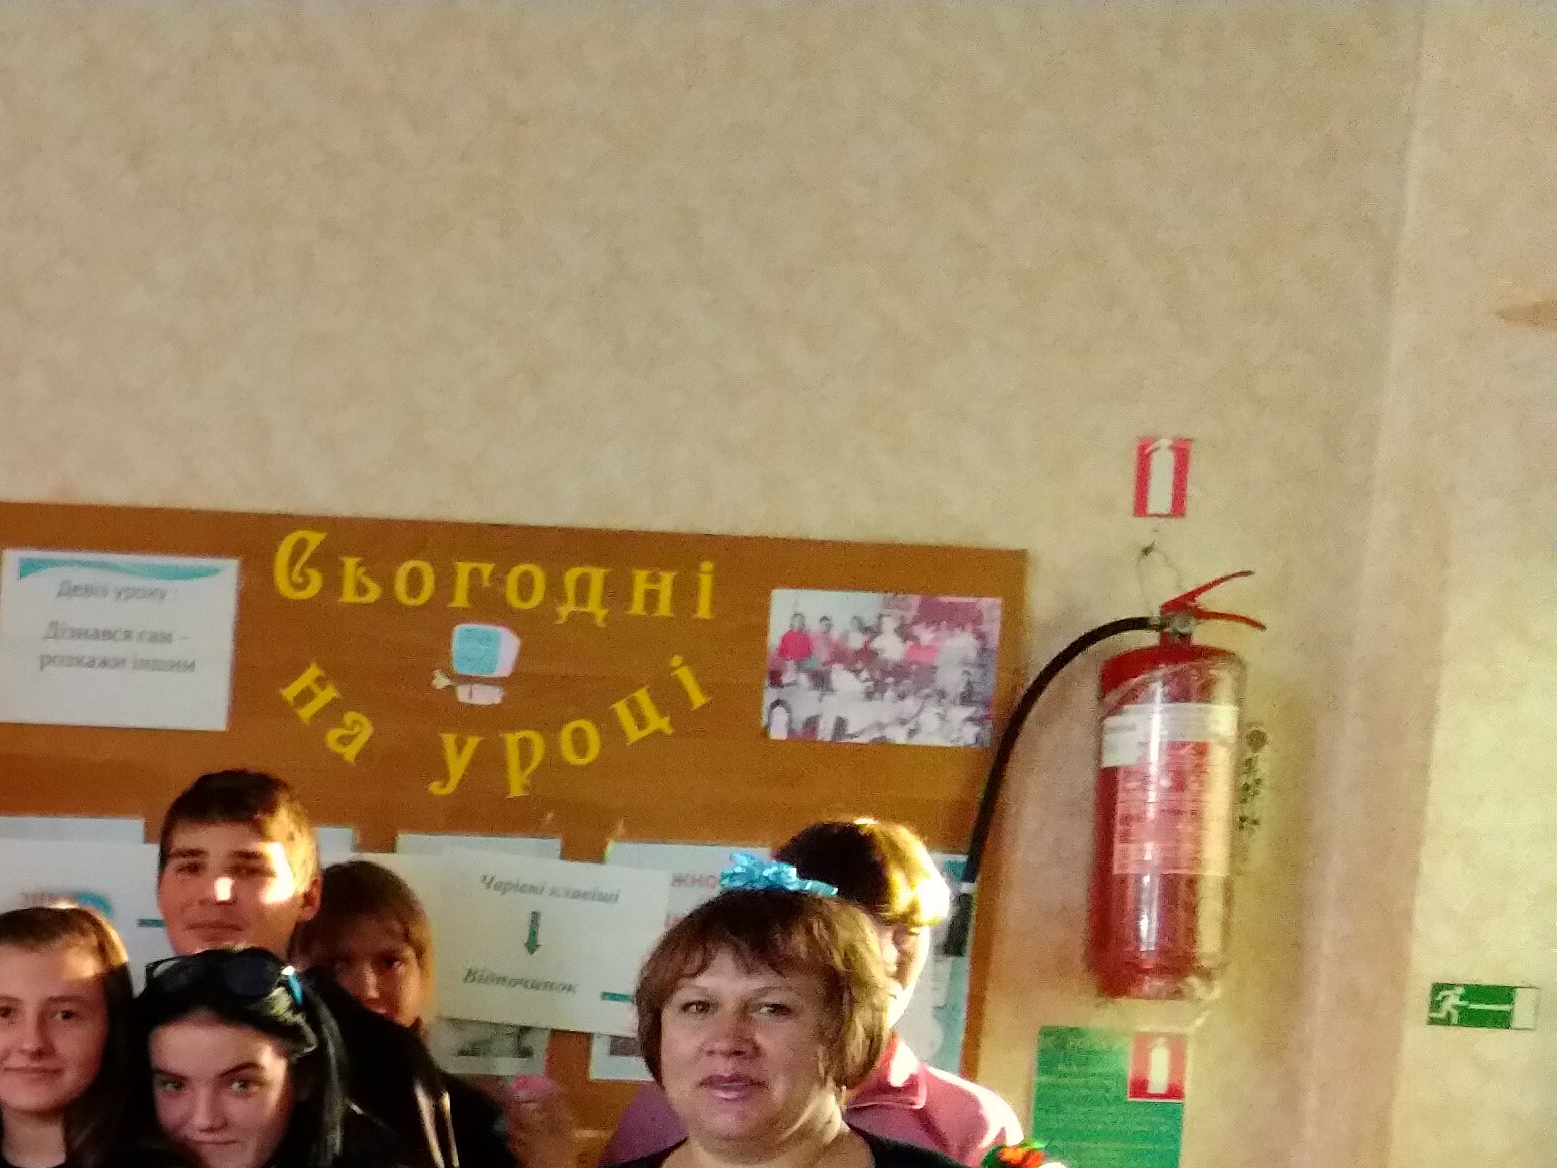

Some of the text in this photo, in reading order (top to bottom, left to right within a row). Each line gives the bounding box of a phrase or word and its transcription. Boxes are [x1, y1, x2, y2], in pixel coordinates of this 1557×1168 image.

[271, 526, 716, 629] Сьогодні
[281, 655, 713, 798] на уроці
